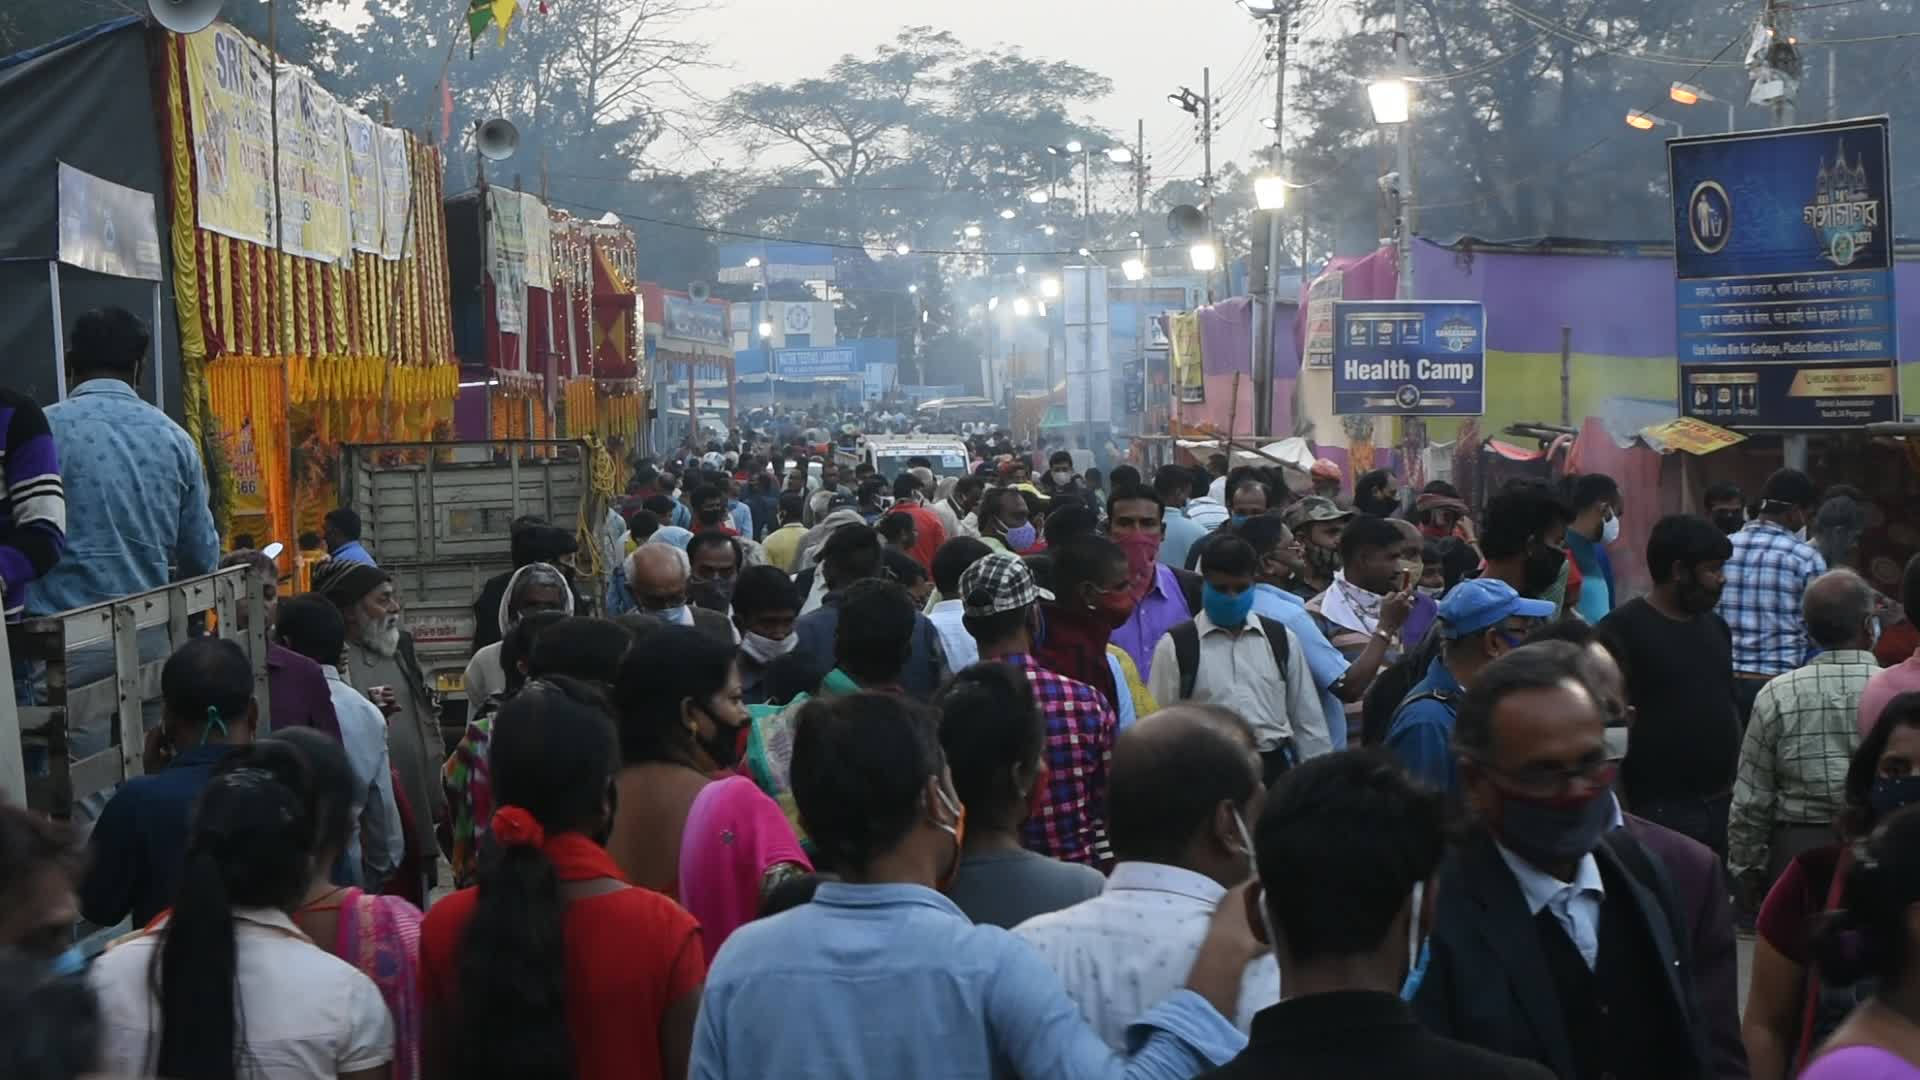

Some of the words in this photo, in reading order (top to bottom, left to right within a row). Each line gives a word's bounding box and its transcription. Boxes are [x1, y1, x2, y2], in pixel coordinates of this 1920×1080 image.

[215, 32, 244, 95] SRI
[1344, 359, 1410, 380] Health
[1417, 358, 1474, 384] Camp
